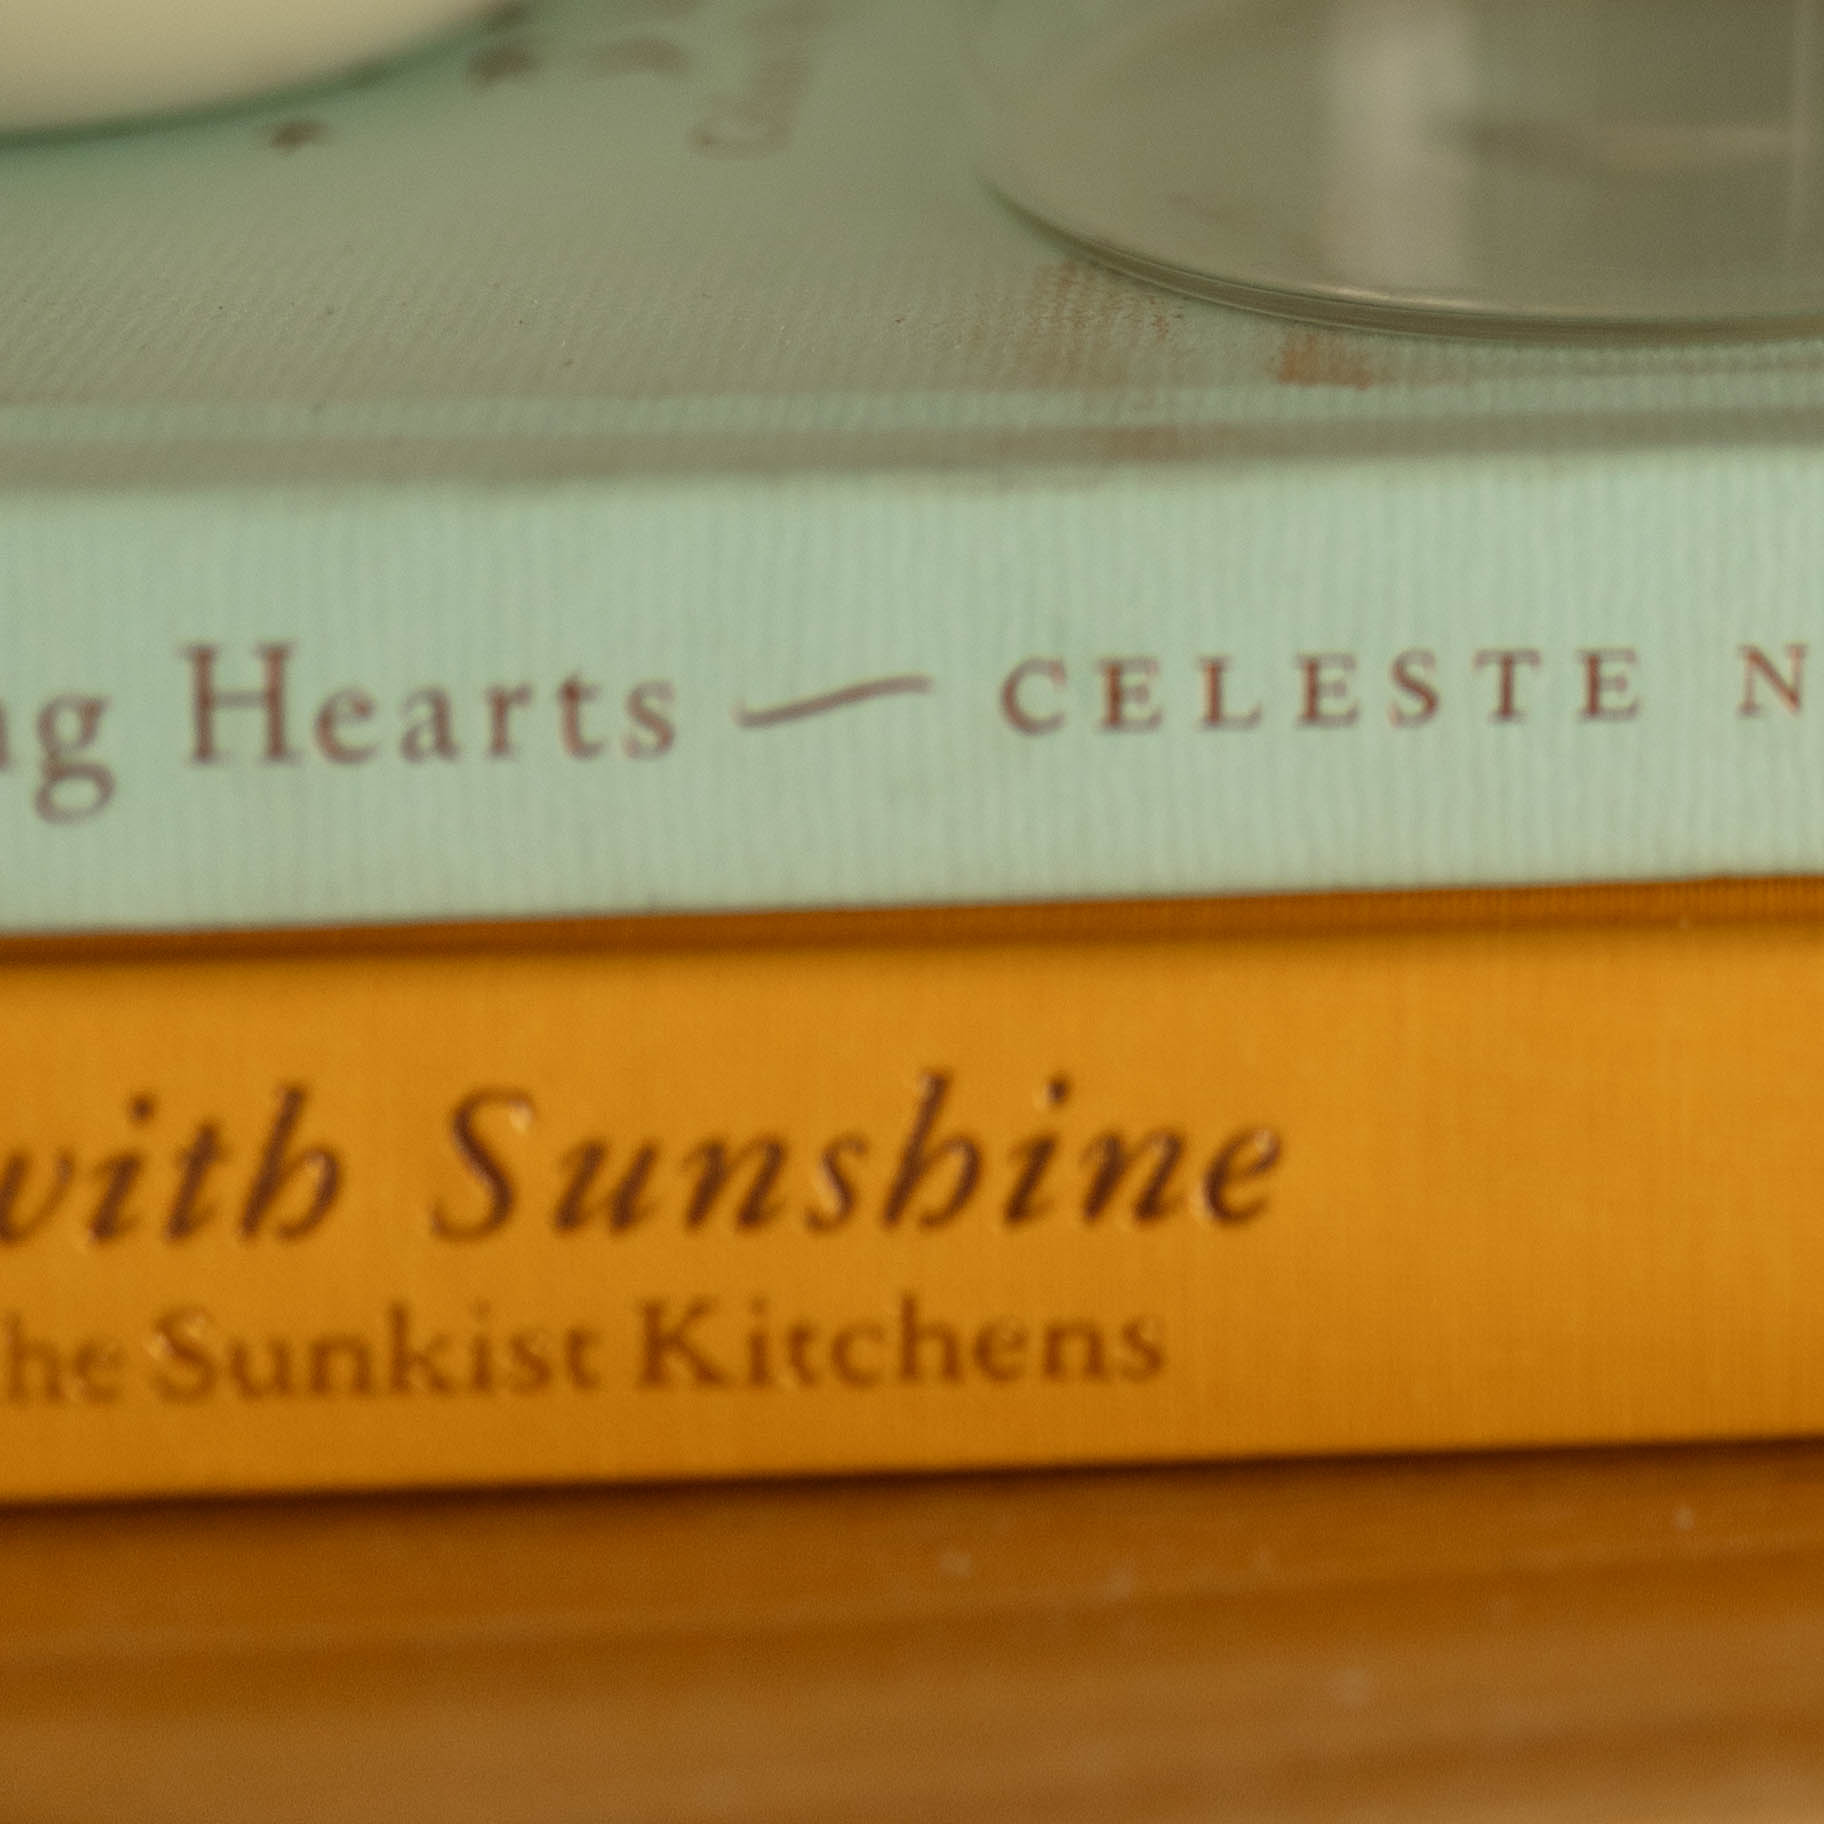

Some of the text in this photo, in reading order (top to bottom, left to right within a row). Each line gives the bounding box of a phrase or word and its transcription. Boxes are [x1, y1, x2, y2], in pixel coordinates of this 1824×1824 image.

[0, 692, 116, 824] g
[180, 640, 678, 764] Hearts
[1000, 648, 1642, 737] CELESTE
[428, 1068, 1283, 1244] Sunshine
[148, 1295, 604, 1406] Sunkist
[632, 1290, 1170, 1394] Kitchens
